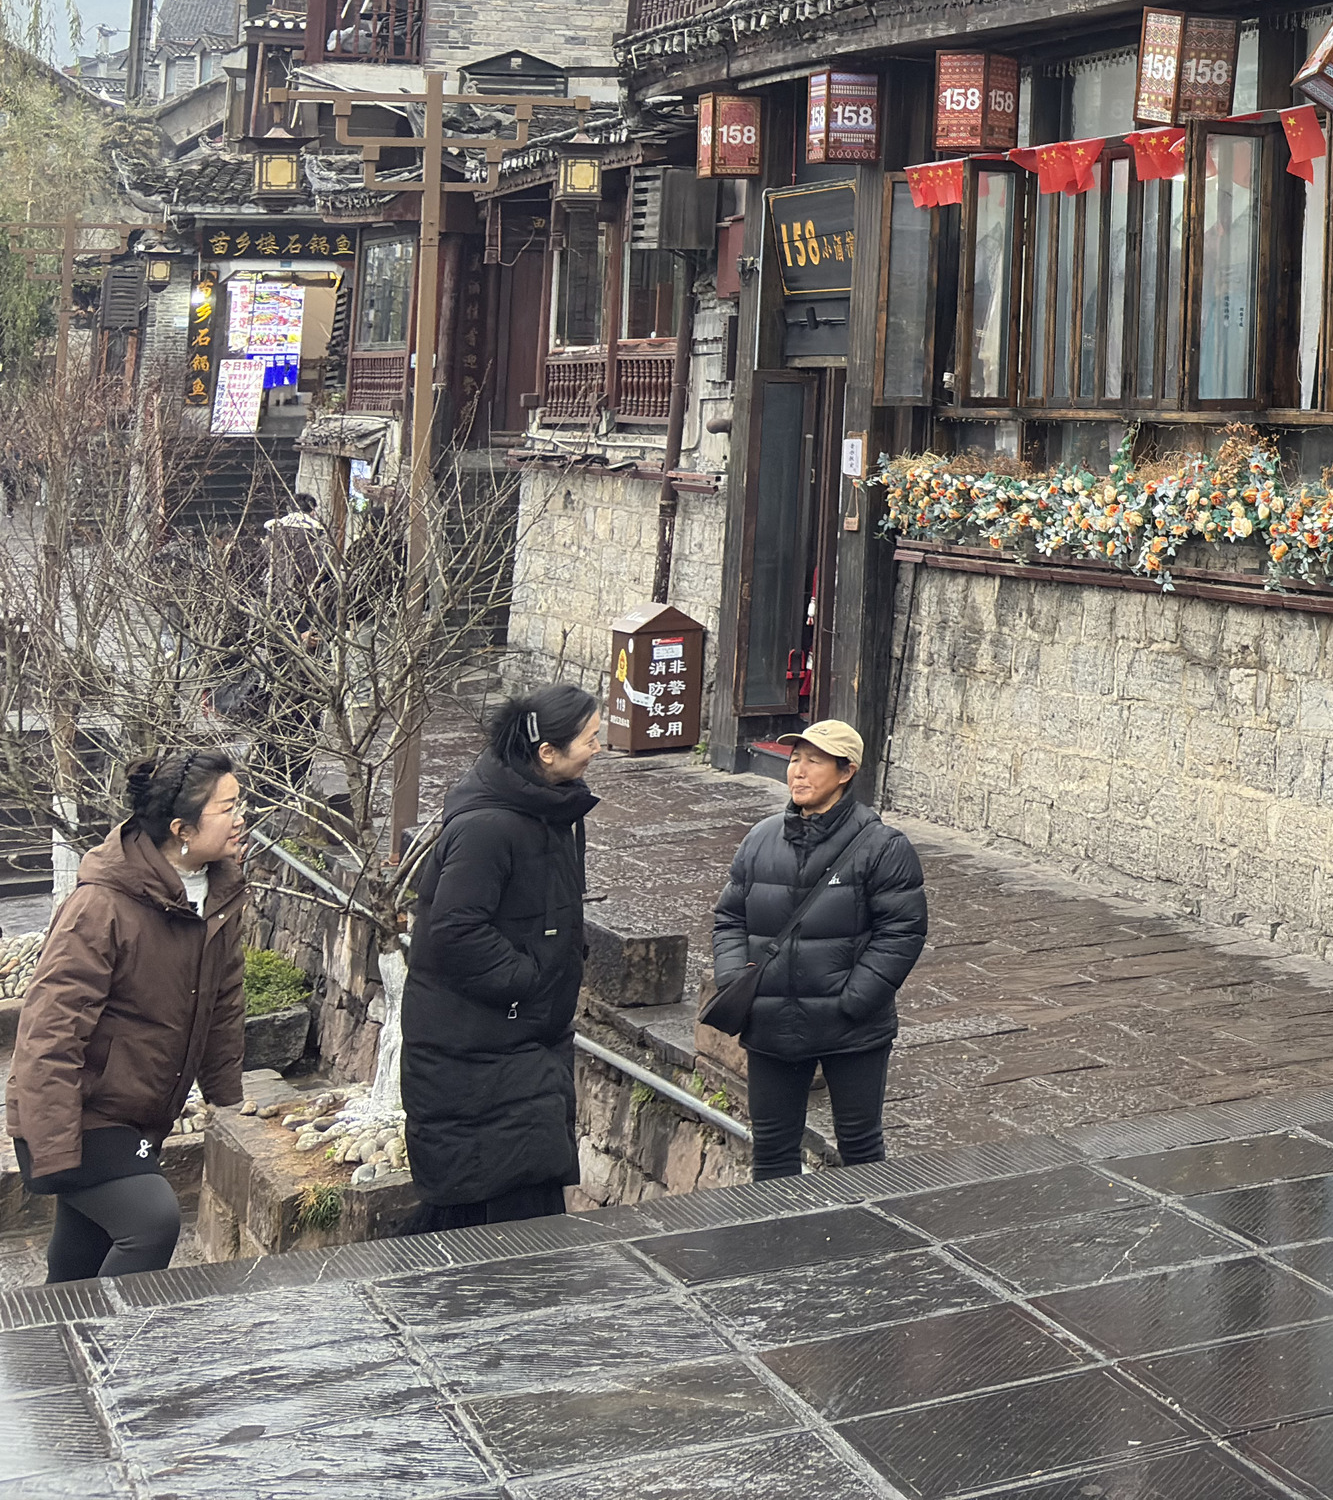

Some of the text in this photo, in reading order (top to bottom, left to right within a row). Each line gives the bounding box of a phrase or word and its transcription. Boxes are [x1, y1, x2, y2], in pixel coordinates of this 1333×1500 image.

[1146, 54, 1174, 81] 158
[1185, 59, 1228, 84] 158
[942, 88, 980, 110] 158
[989, 90, 1014, 113] 158
[811, 105, 825, 126] 158
[833, 106, 872, 126] 158
[718, 125, 756, 144] 158
[646, 660, 687, 738] 消防设备 非警勿用
